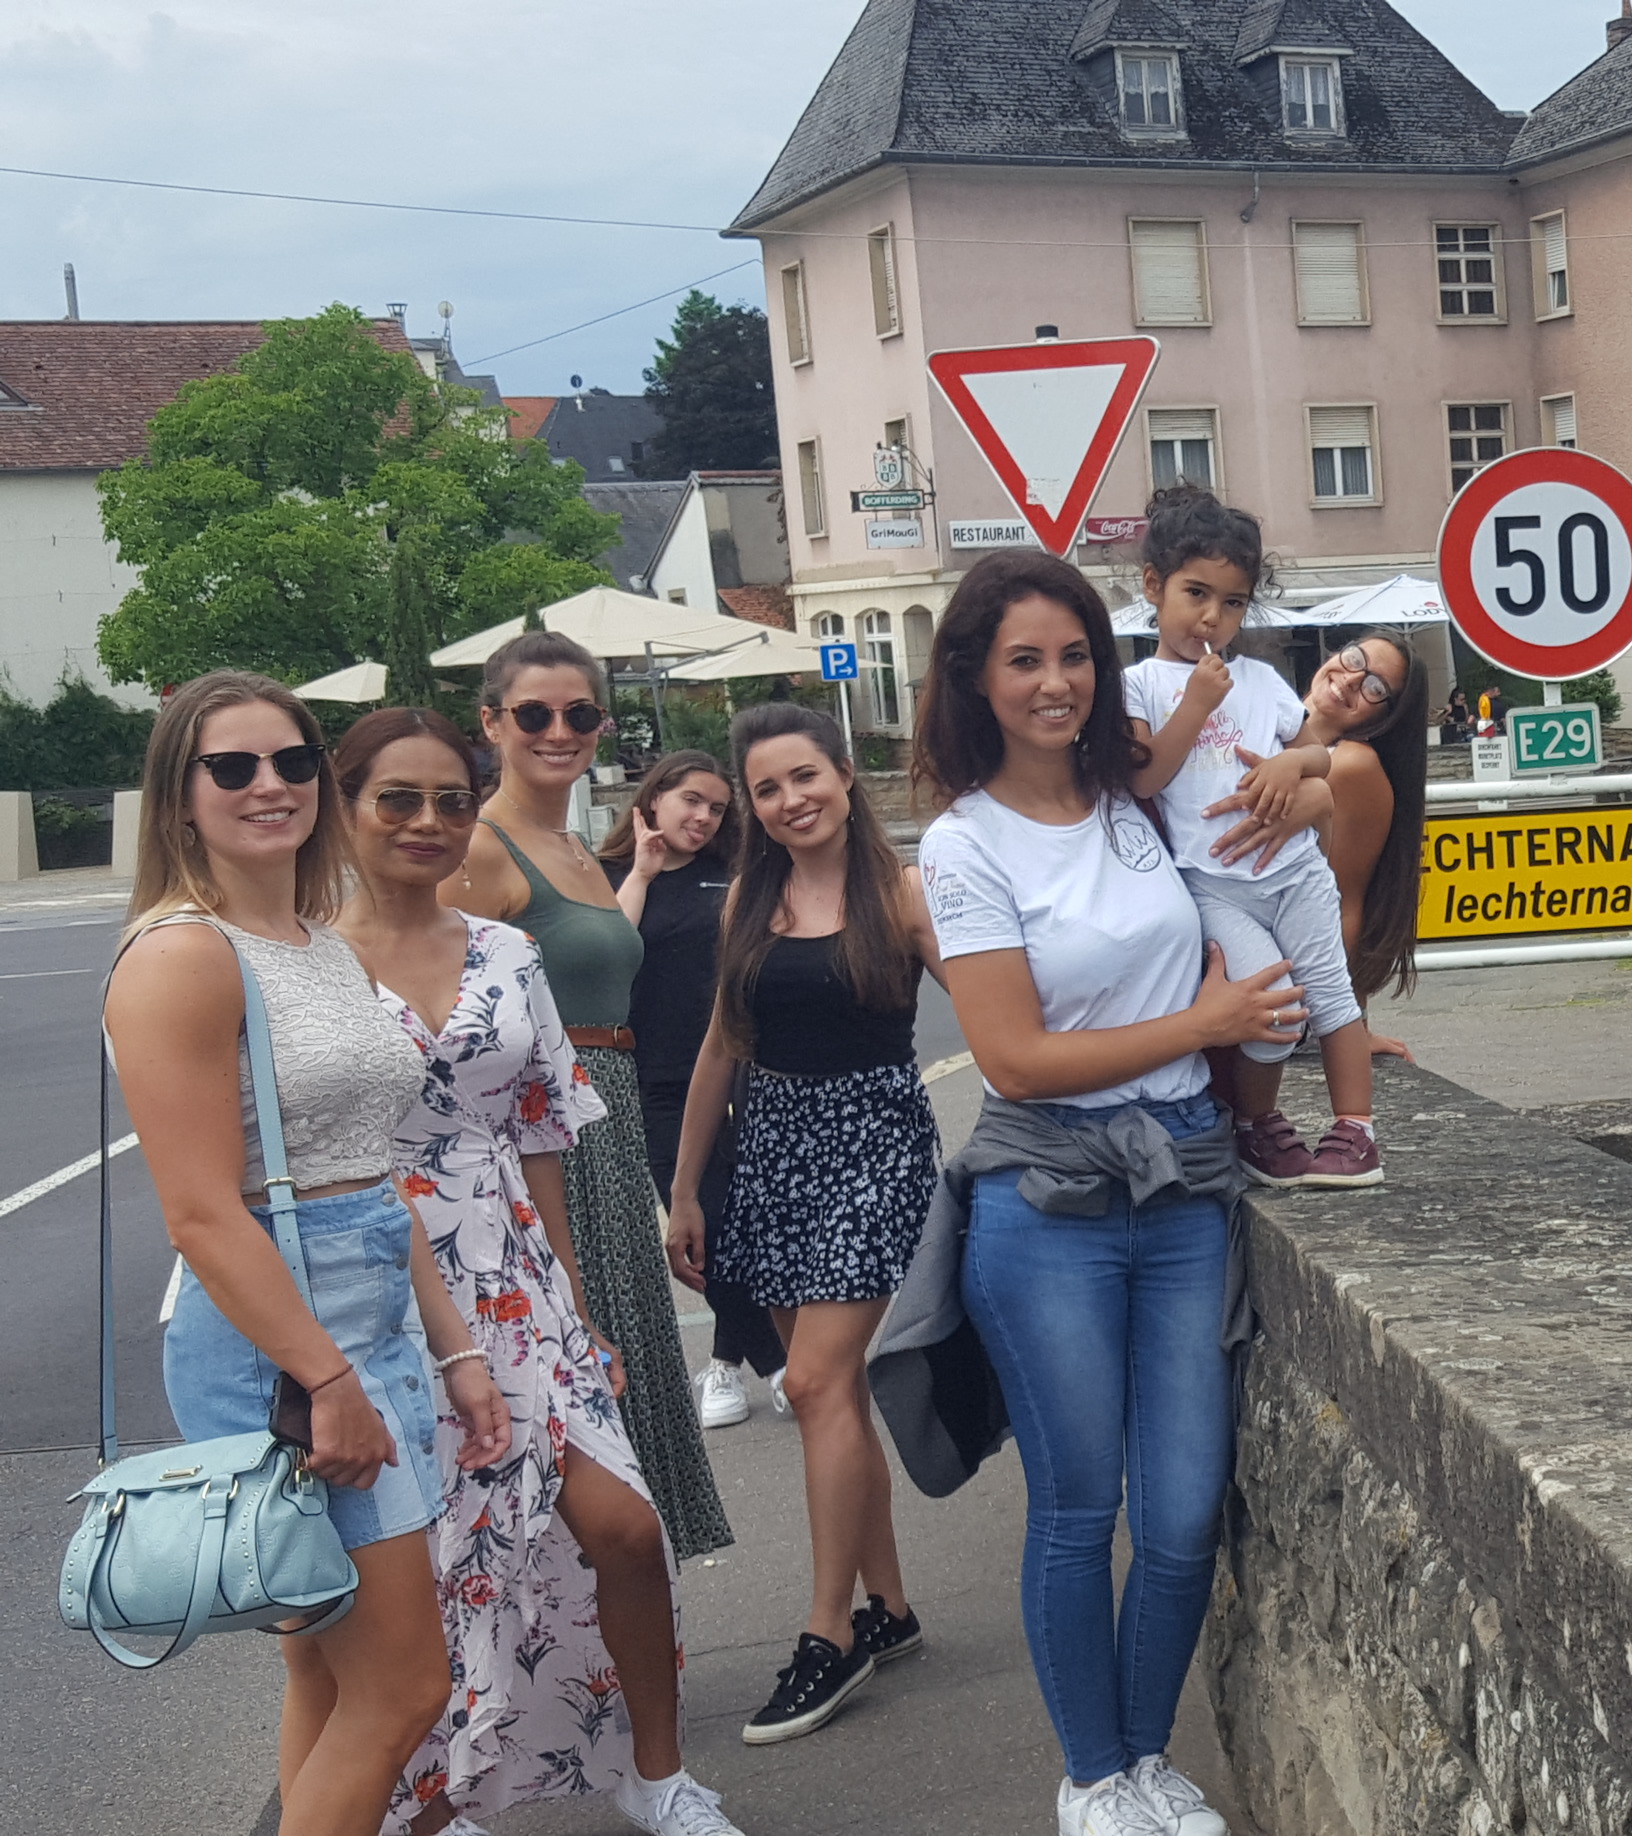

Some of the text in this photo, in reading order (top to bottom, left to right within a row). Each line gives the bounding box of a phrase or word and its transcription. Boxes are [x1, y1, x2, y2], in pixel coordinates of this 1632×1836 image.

[871, 527, 918, 538] GriMouGi
[953, 526, 1026, 542] RESTAURANT
[1494, 512, 1611, 617] 50
[828, 648, 848, 676] P
[1519, 717, 1592, 762] E29
